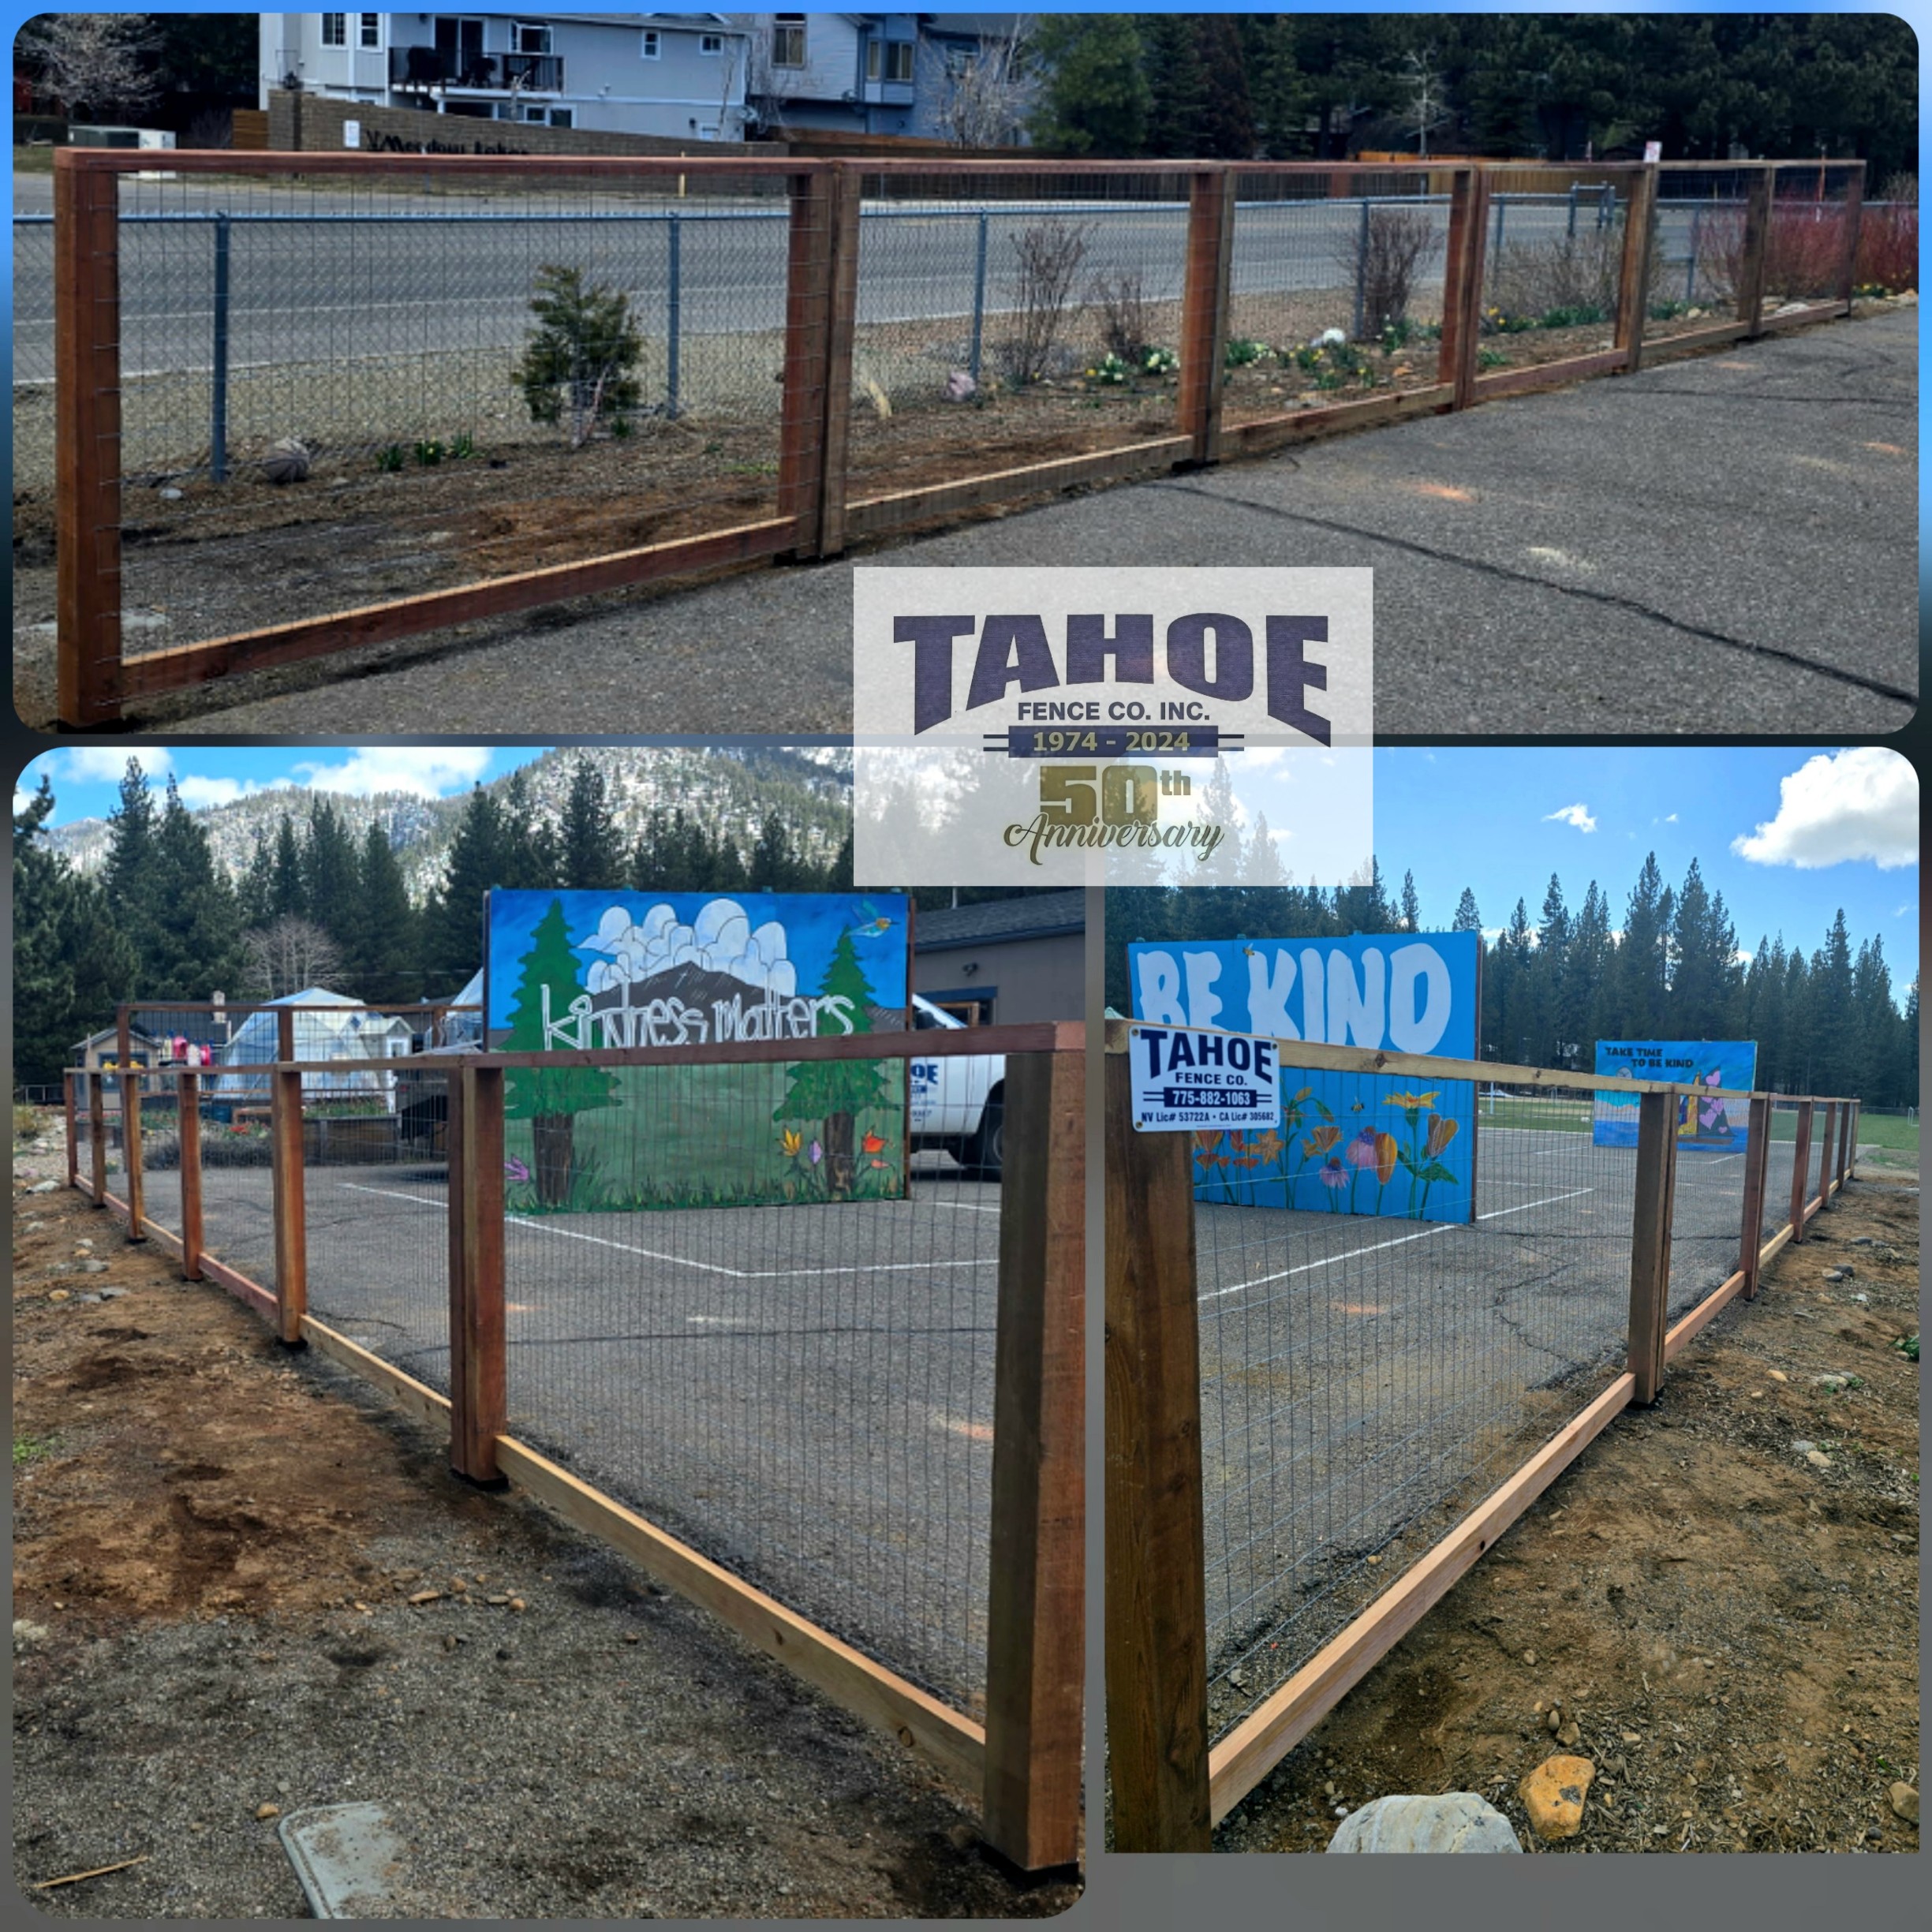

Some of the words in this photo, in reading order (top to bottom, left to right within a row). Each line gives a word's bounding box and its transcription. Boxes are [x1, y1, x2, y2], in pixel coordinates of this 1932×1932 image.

[1137, 951, 1239, 1033] BE
[1247, 943, 1452, 1054] KIND
[1141, 1029, 1272, 1085] TAHOE
[1605, 1047, 1633, 1056] TAKE
[1636, 1048, 1663, 1057] TIME
[1631, 1059, 1646, 1067] TO
[1649, 1059, 1662, 1067] BE
[1665, 1059, 1694, 1068] KIND
[1175, 1072, 1221, 1085] FENCE
[1226, 1074, 1248, 1086] CO.
[1172, 1090, 1250, 1105] 775-882-1063
[1142, 1112, 1153, 1123] NV
[1156, 1112, 1175, 1123] Lic#
[1179, 1112, 1210, 1122] 53722A
[1219, 1112, 1229, 1121] CA
[1231, 1112, 1247, 1121] Lic#
